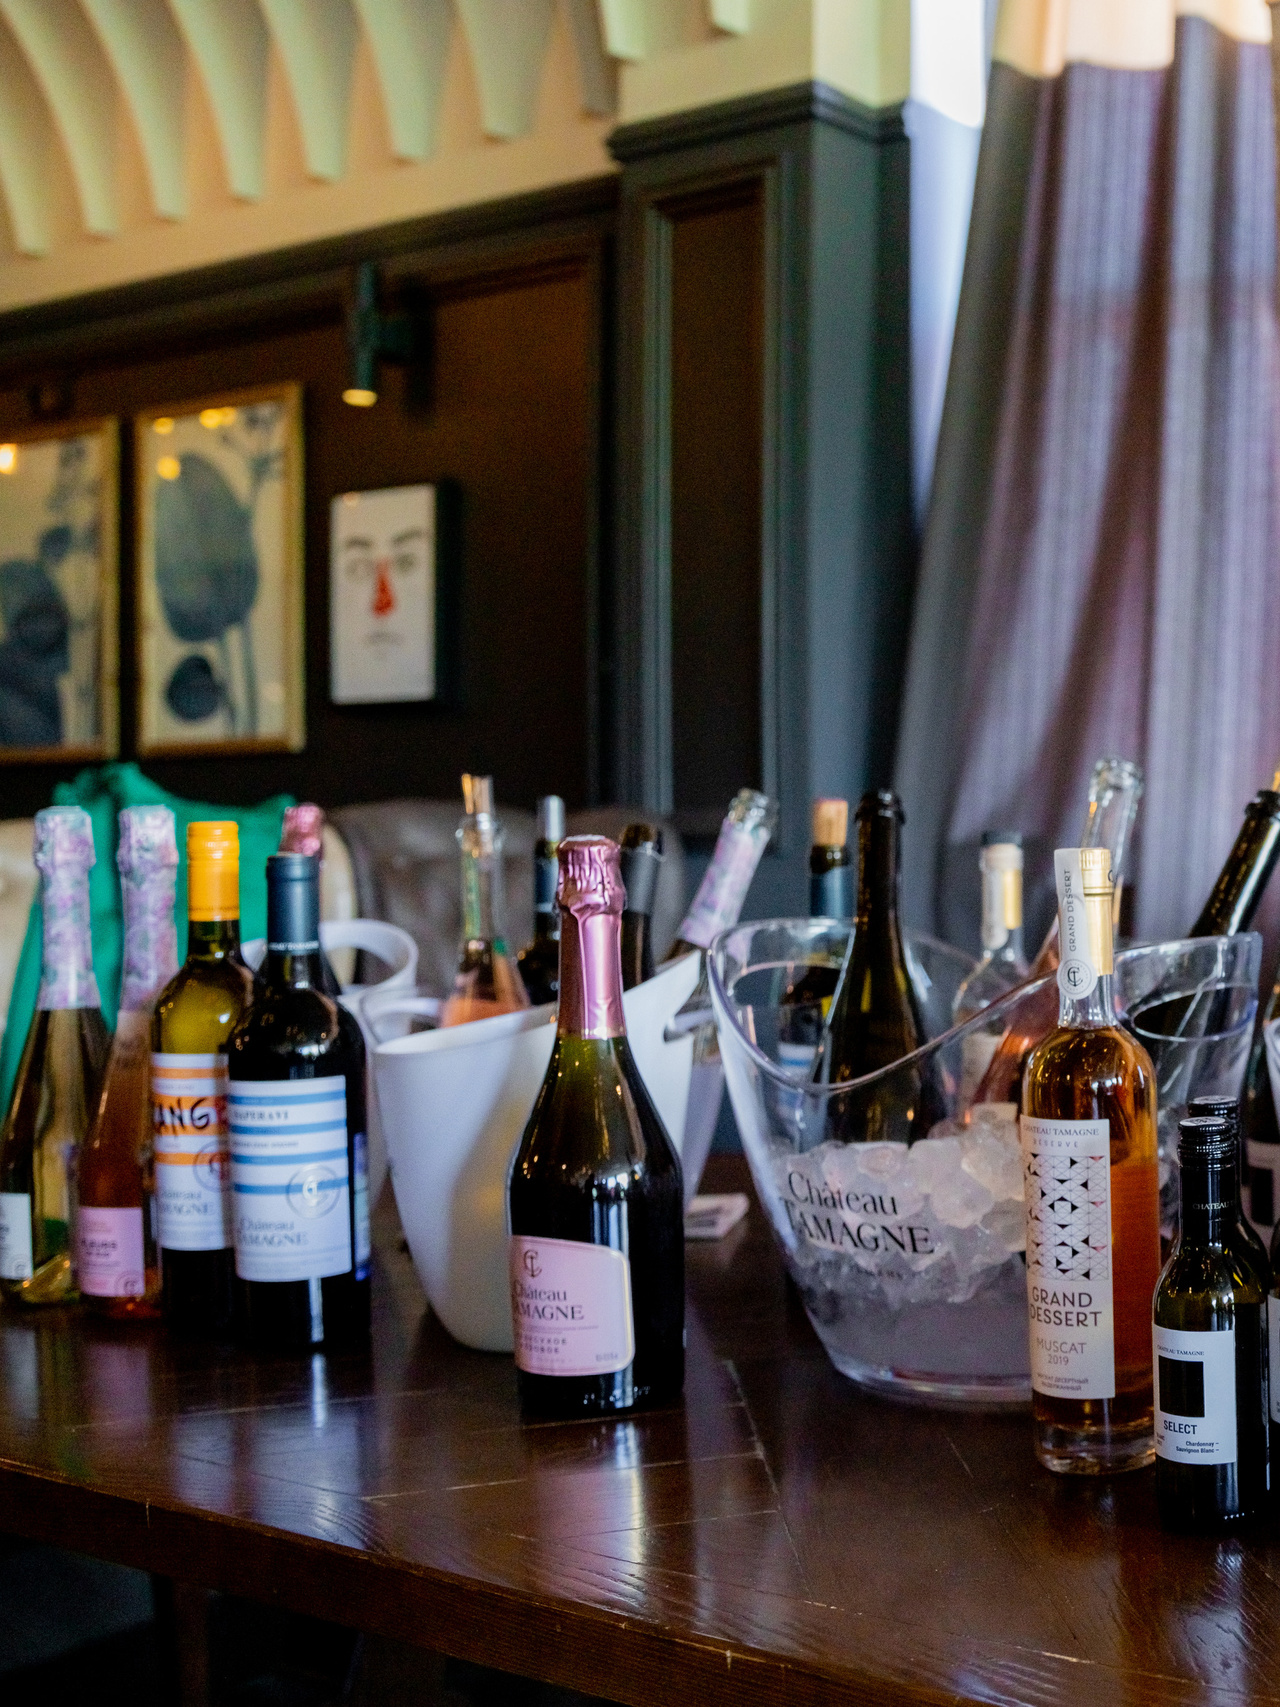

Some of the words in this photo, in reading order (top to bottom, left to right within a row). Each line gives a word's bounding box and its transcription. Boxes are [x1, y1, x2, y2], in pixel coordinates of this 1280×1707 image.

[1063, 869, 1075, 912] DESSERT
[1068, 917, 1077, 951] GRAND
[1053, 1128, 1099, 1136] TAMAGNE
[788, 1171, 898, 1215] Château
[779, 1197, 935, 1254] TAMAGNE
[1032, 1286, 1092, 1308] GRAND
[1029, 1304, 1102, 1327] DESSERT
[1037, 1337, 1087, 1354] MUSCAT
[1048, 1354, 1069, 1366] 2019
[1163, 1420, 1197, 1434] SELECT
[1176, 1446, 1200, 1454] Sauvignon
